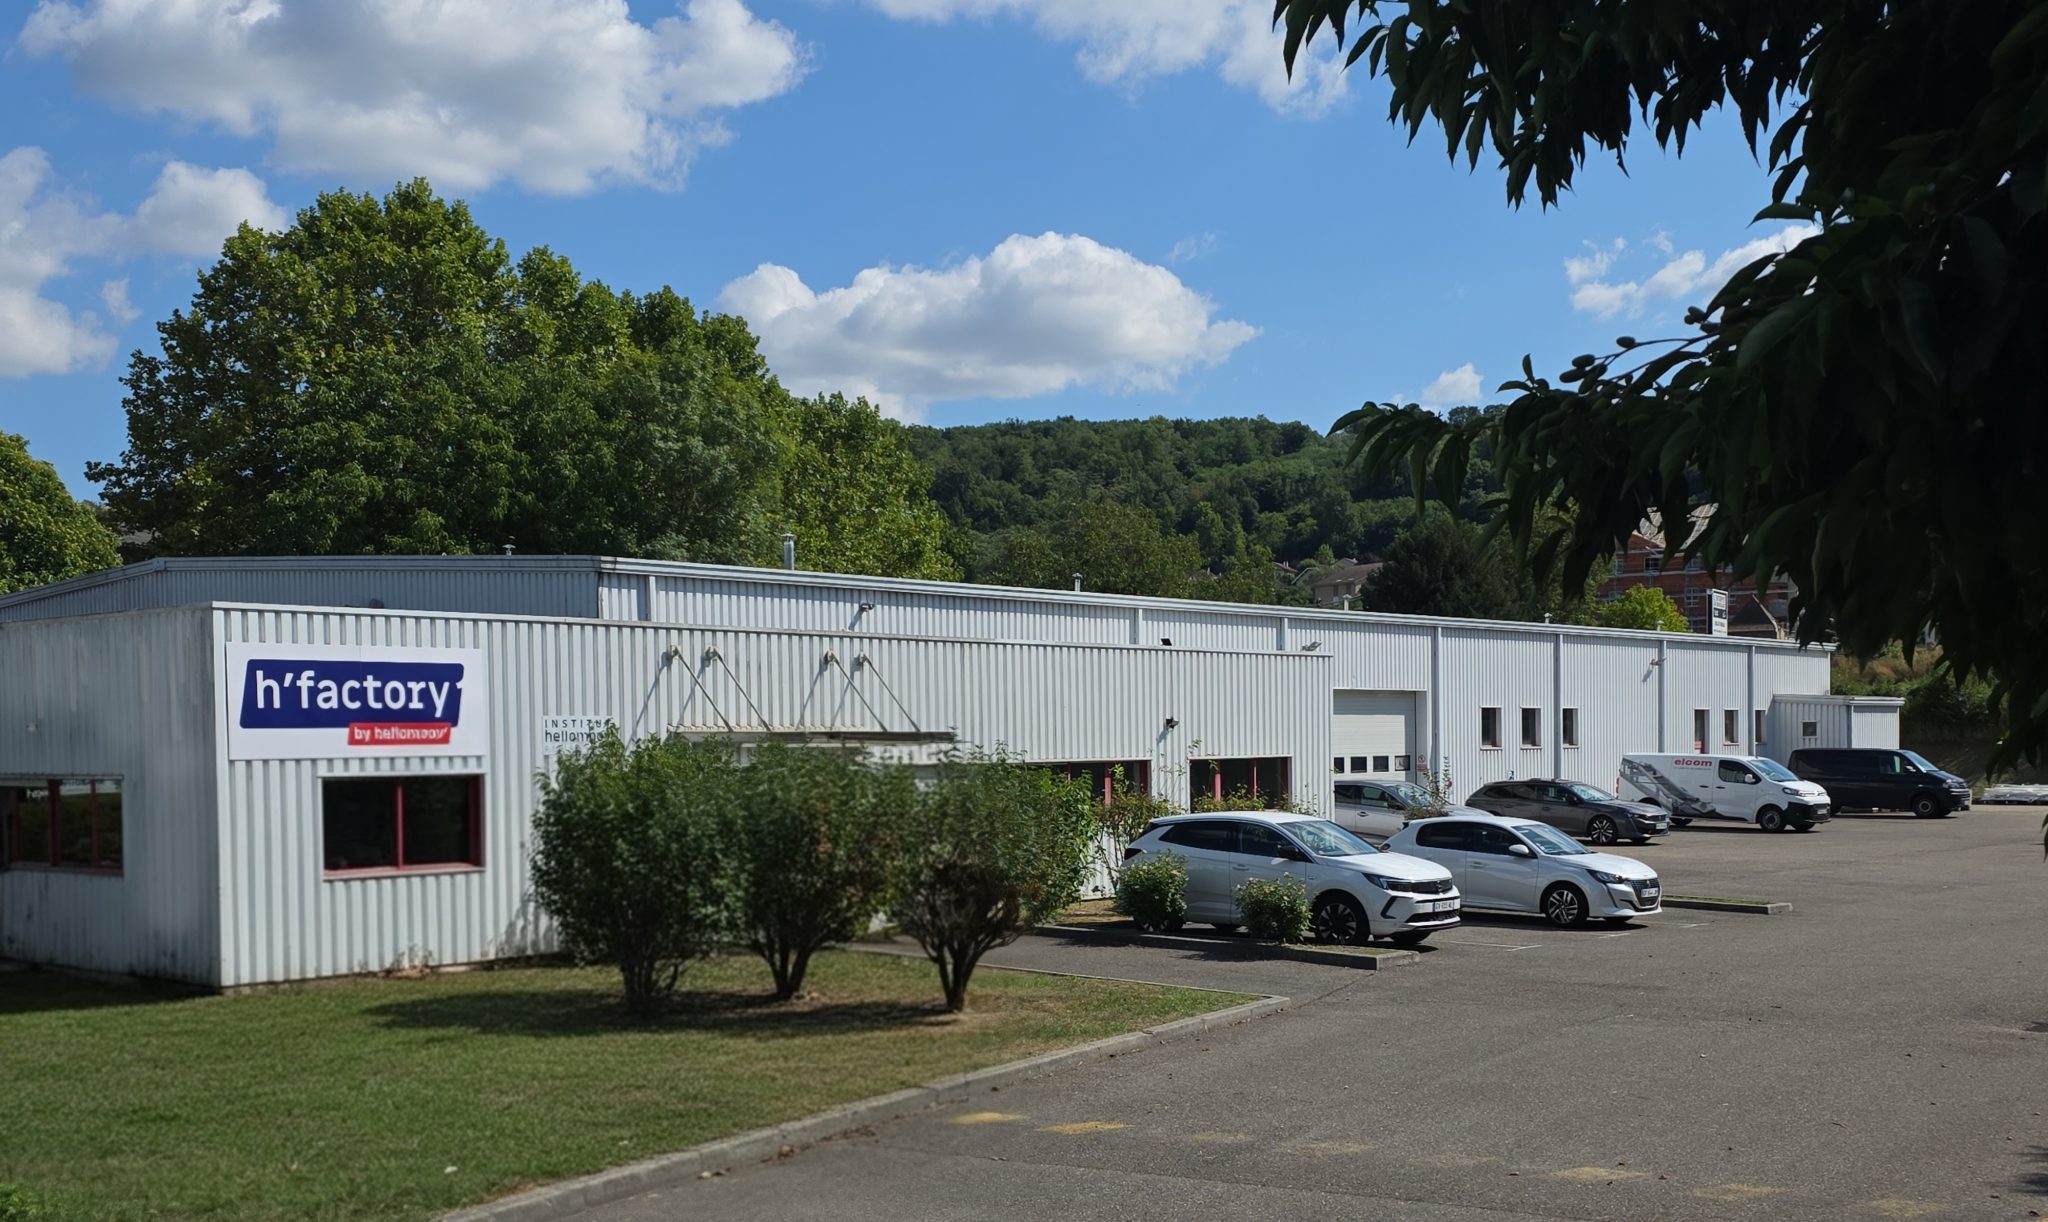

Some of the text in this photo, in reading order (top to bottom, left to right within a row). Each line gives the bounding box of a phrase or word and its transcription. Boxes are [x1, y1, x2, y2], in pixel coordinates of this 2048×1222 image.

[545, 719, 611, 728] INSTITU
[354, 726, 371, 742] by
[1674, 758, 1712, 766] elcom
